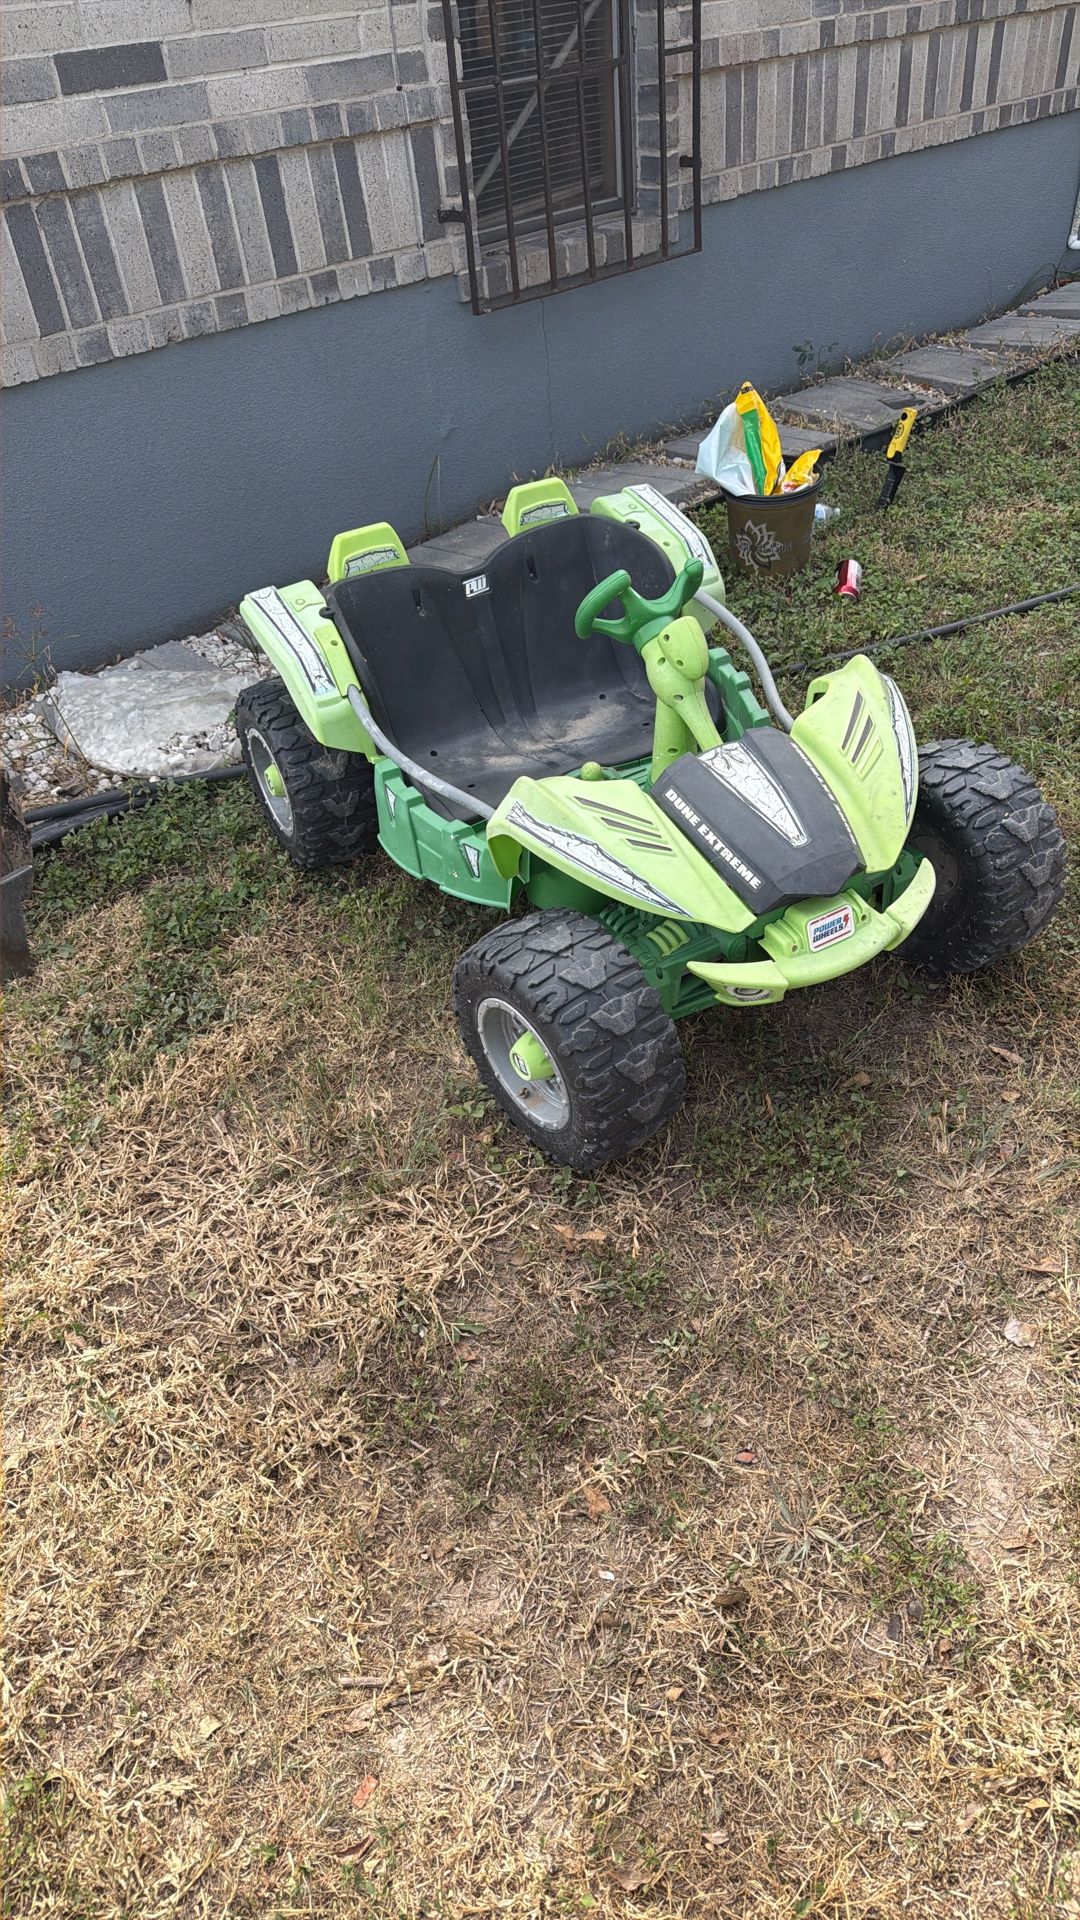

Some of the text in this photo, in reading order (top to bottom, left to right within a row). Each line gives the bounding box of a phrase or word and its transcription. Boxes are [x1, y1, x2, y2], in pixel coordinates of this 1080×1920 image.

[664, 788, 763, 890] DUNE EXTREME
[812, 923, 844, 944] WHEELS
[813, 916, 843, 936] POWER
